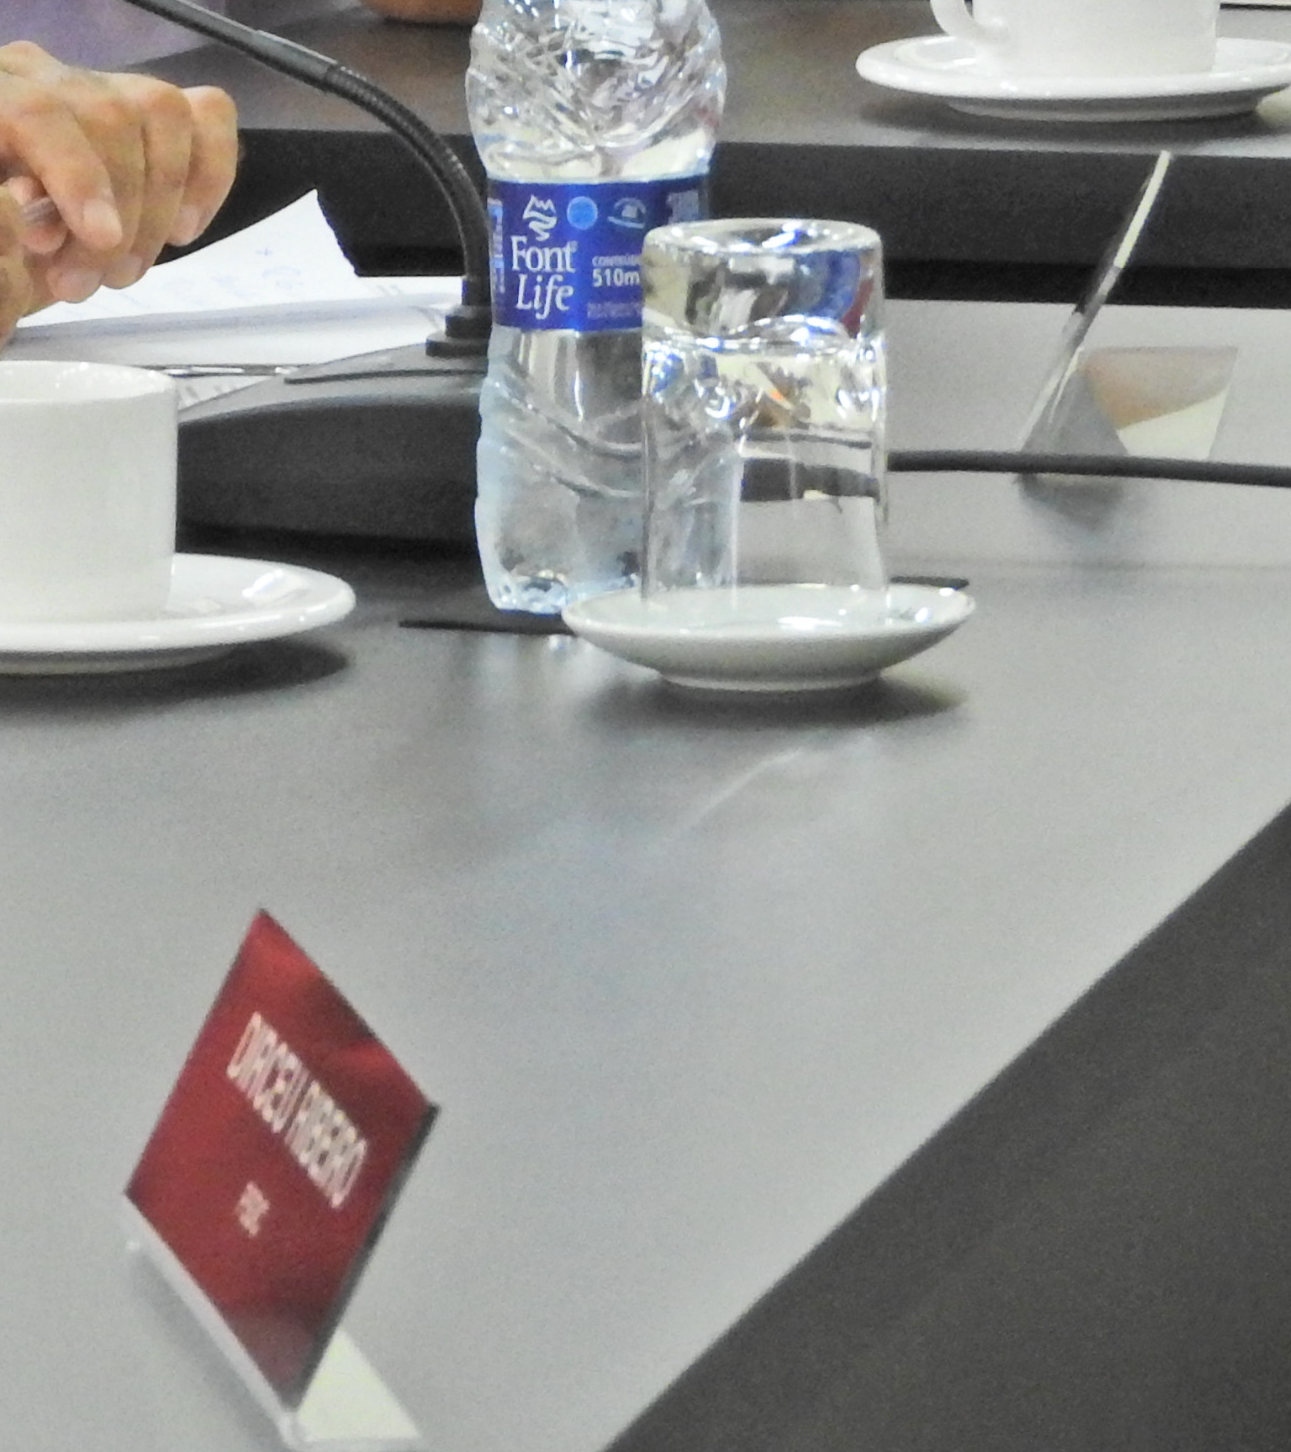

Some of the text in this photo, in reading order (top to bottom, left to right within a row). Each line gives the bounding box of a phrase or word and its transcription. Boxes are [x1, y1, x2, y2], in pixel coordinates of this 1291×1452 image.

[510, 235, 578, 274] Font
[592, 267, 641, 287] 510m
[516, 274, 574, 320] Life
